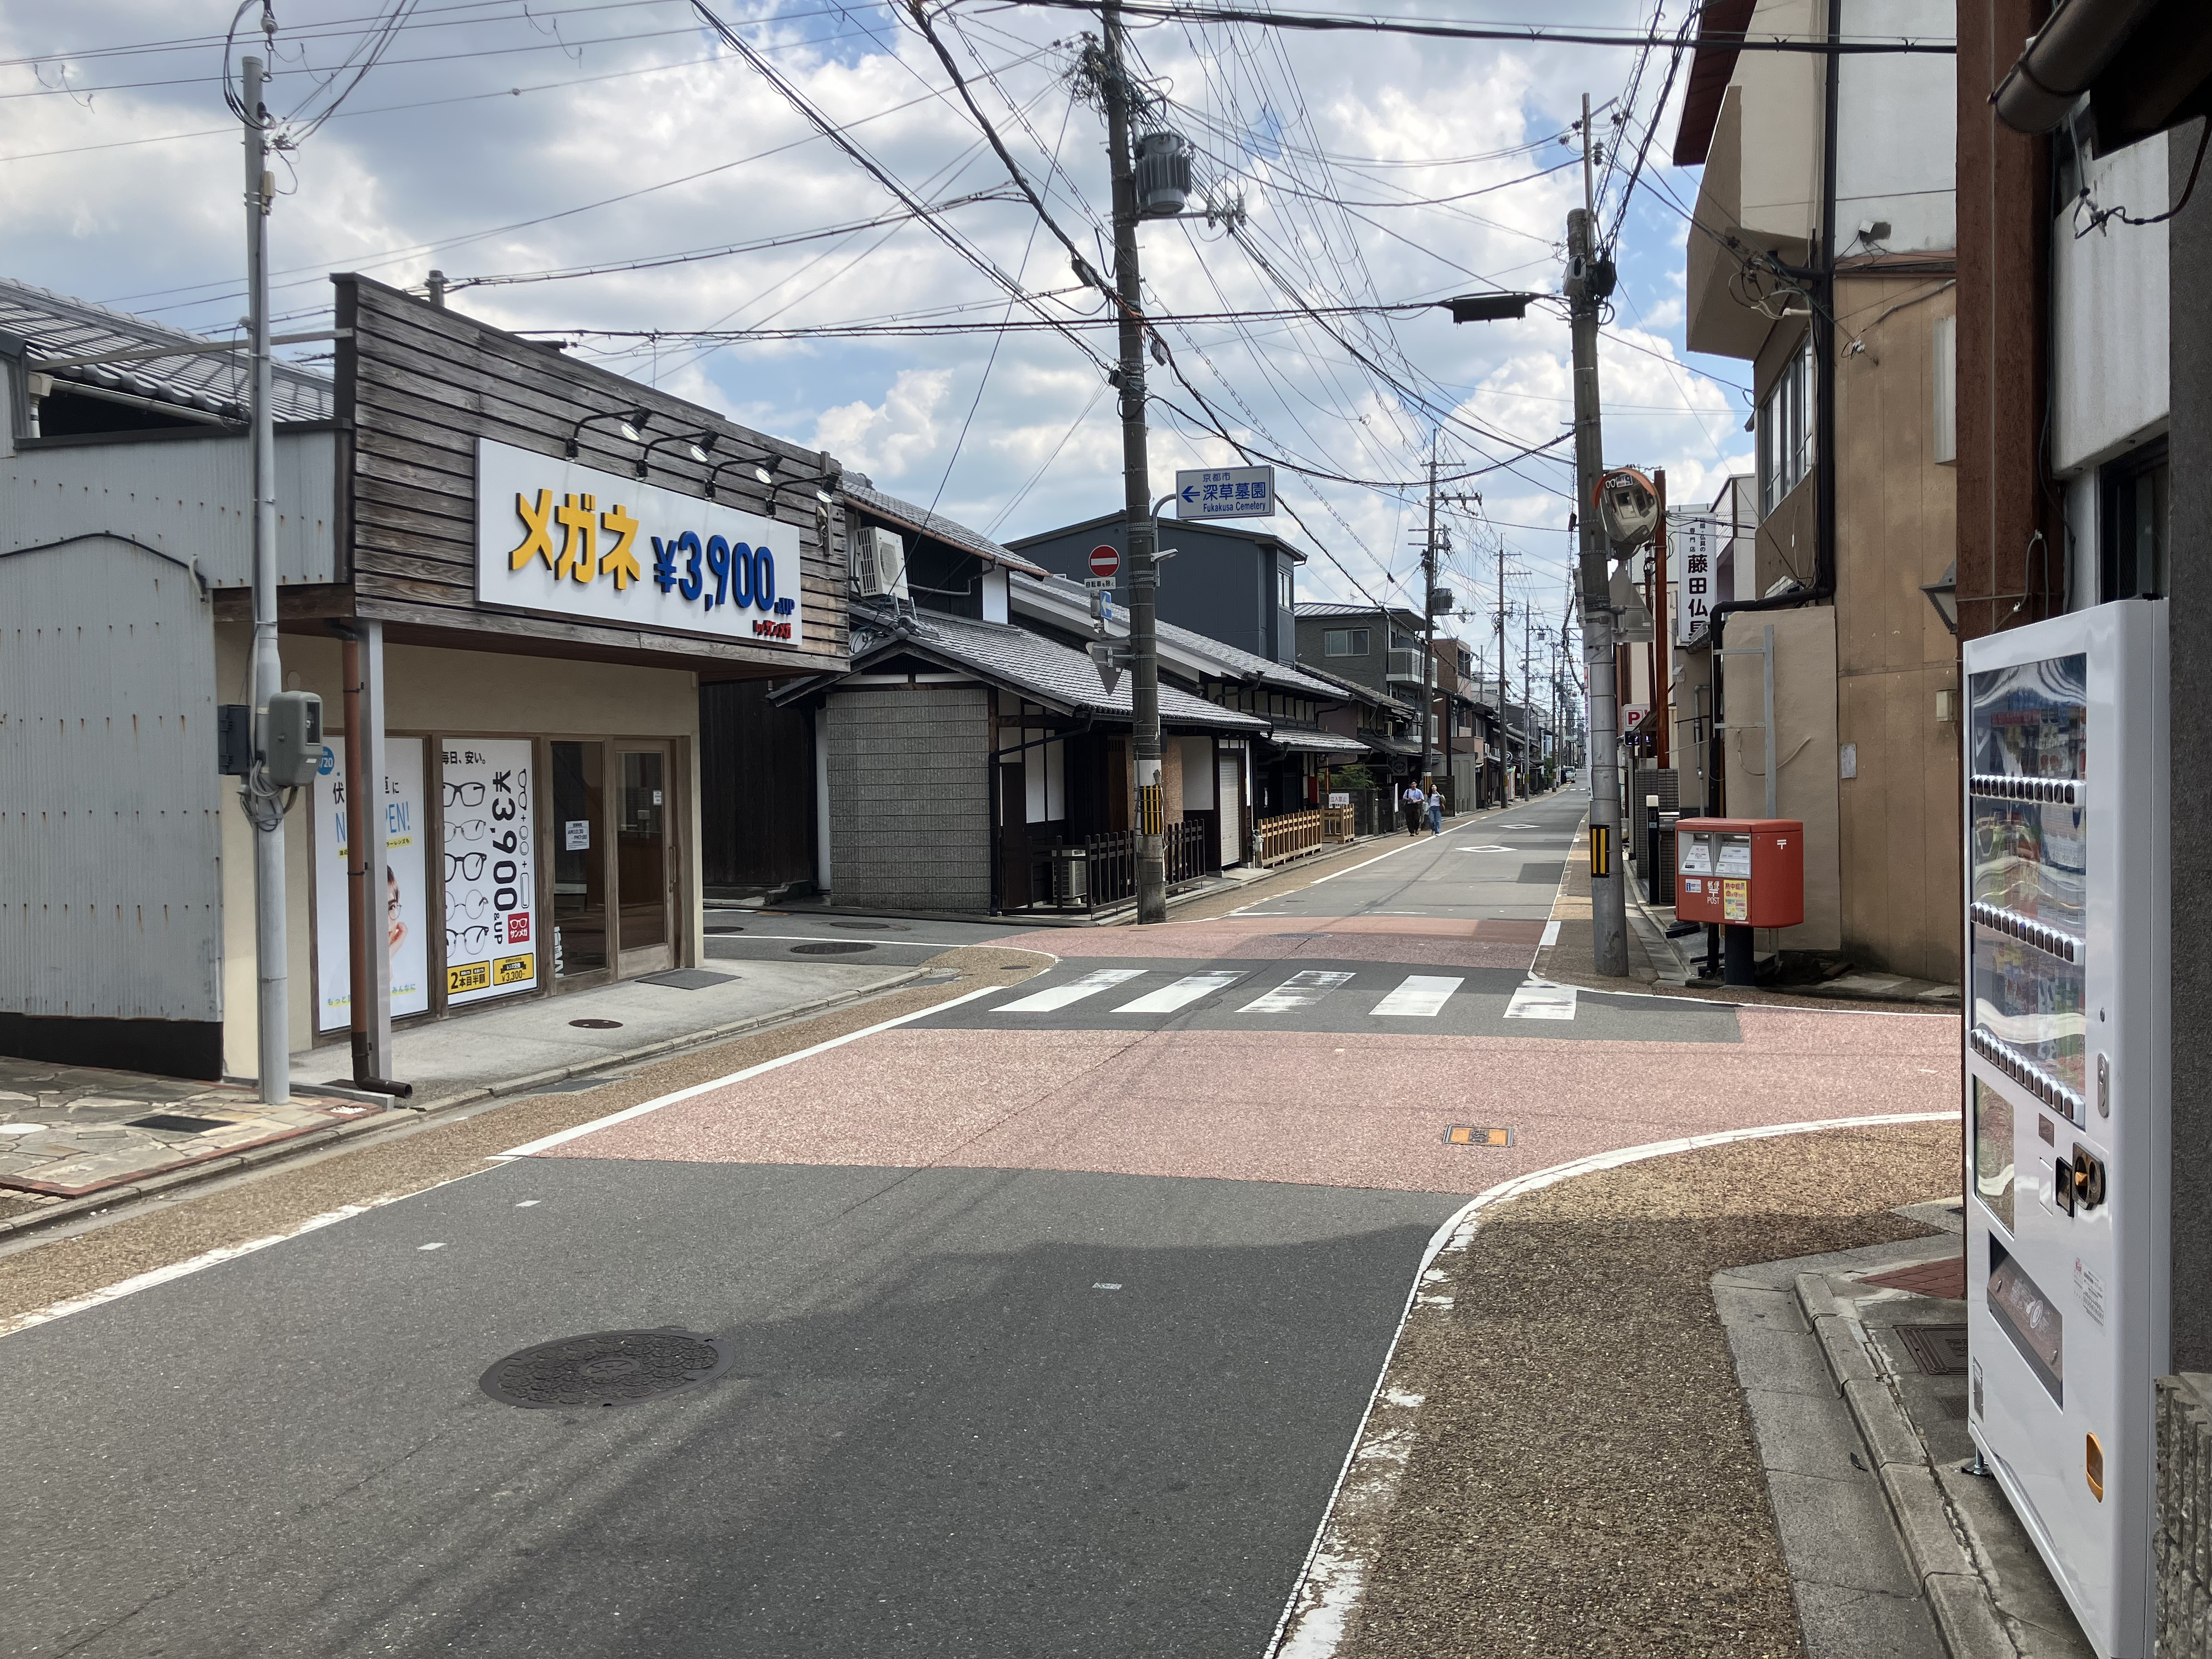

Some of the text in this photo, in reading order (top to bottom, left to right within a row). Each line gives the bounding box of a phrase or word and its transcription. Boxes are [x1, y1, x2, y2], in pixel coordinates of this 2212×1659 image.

[1203, 472, 1231, 482] 京都市
[1203, 482, 1265, 501] 深草墓園
[1203, 501, 1266, 512] Fukakusa Cemetery
[509, 489, 640, 590] メガネ
[651, 531, 775, 612] ¥3,900
[1086, 580, 1115, 588] 自転車を除く
[1628, 712, 1640, 725] P
[490, 770, 517, 945] ¥3,900 &UP
[1707, 896, 1720, 905] POST
[510, 928, 528, 939] サンメガ
[450, 972, 486, 990] 2本目半額
